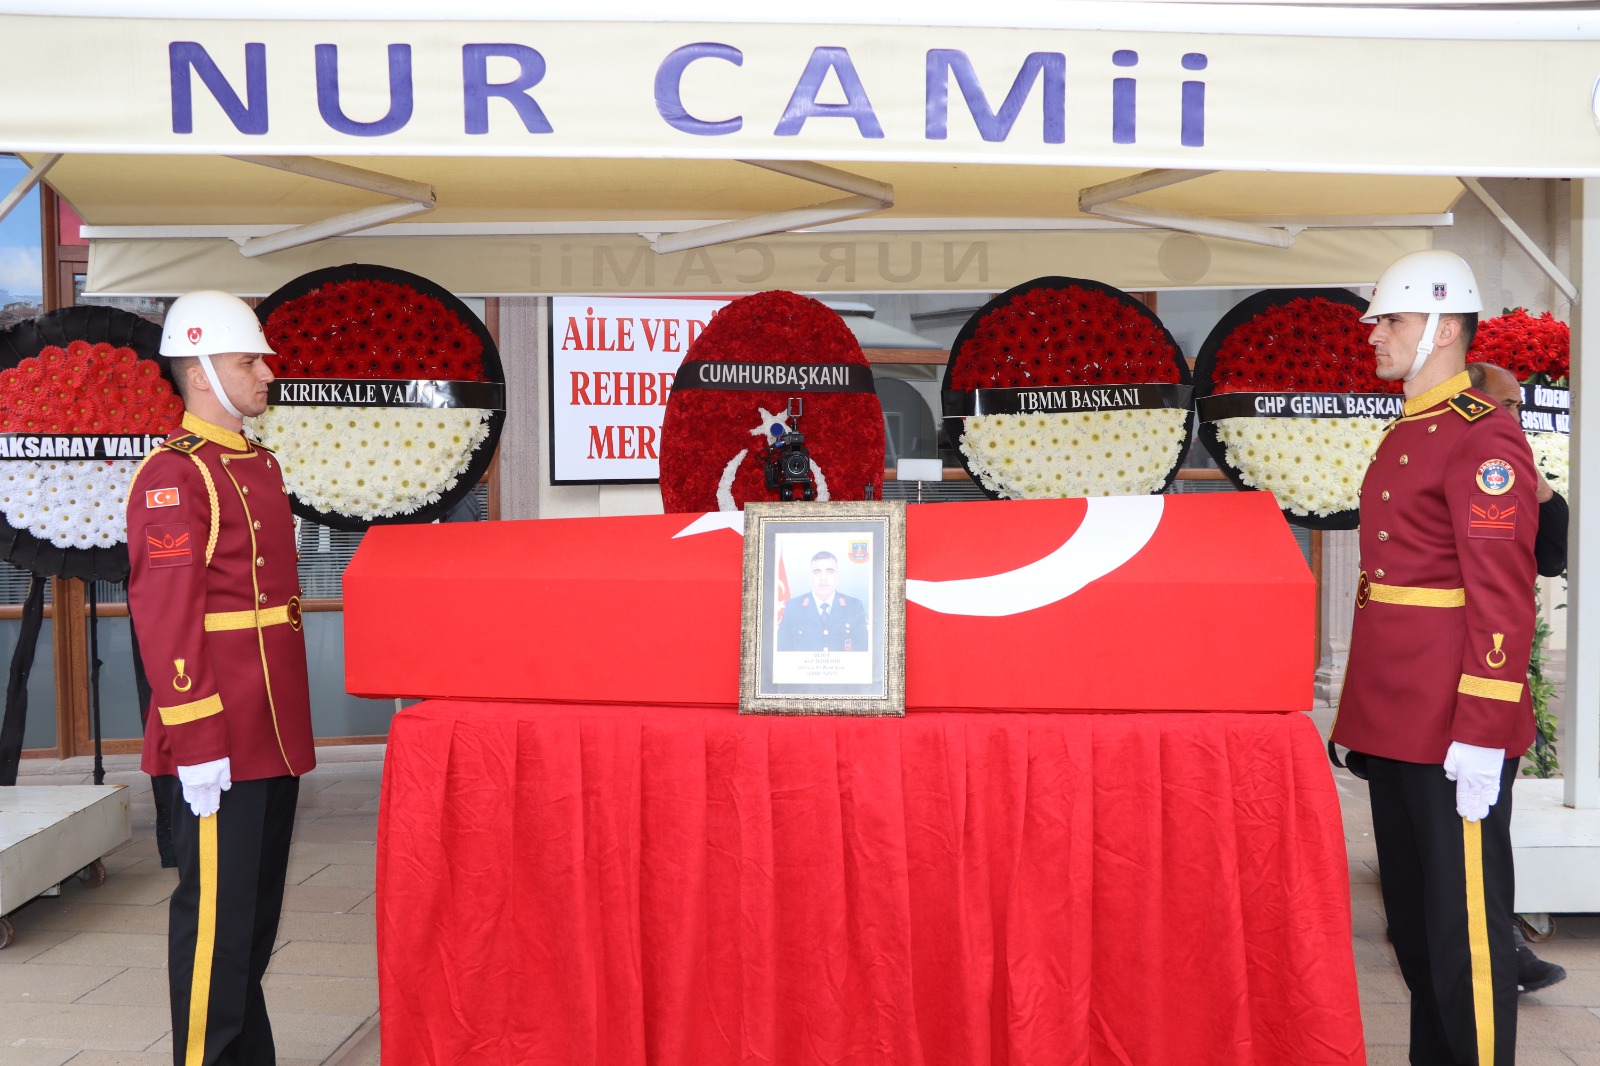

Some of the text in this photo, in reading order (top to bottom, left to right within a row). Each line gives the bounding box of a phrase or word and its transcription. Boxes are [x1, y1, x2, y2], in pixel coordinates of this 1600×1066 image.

[169, 41, 555, 136] NUR
[561, 306, 635, 352] AİLE
[640, 318, 681, 353] VE
[699, 363, 850, 390] CUMHURBAŞKANI
[279, 383, 377, 404] KIRIKKALE
[1017, 388, 1141, 412] TBMM BAŞKANI
[1254, 396, 1286, 414] CHP
[1290, 396, 1342, 414] GENEL
[1521, 410, 1554, 431] SOSYAL
[0, 434, 171, 458] AKSARAY VALİS
[587, 425, 663, 460] MER
